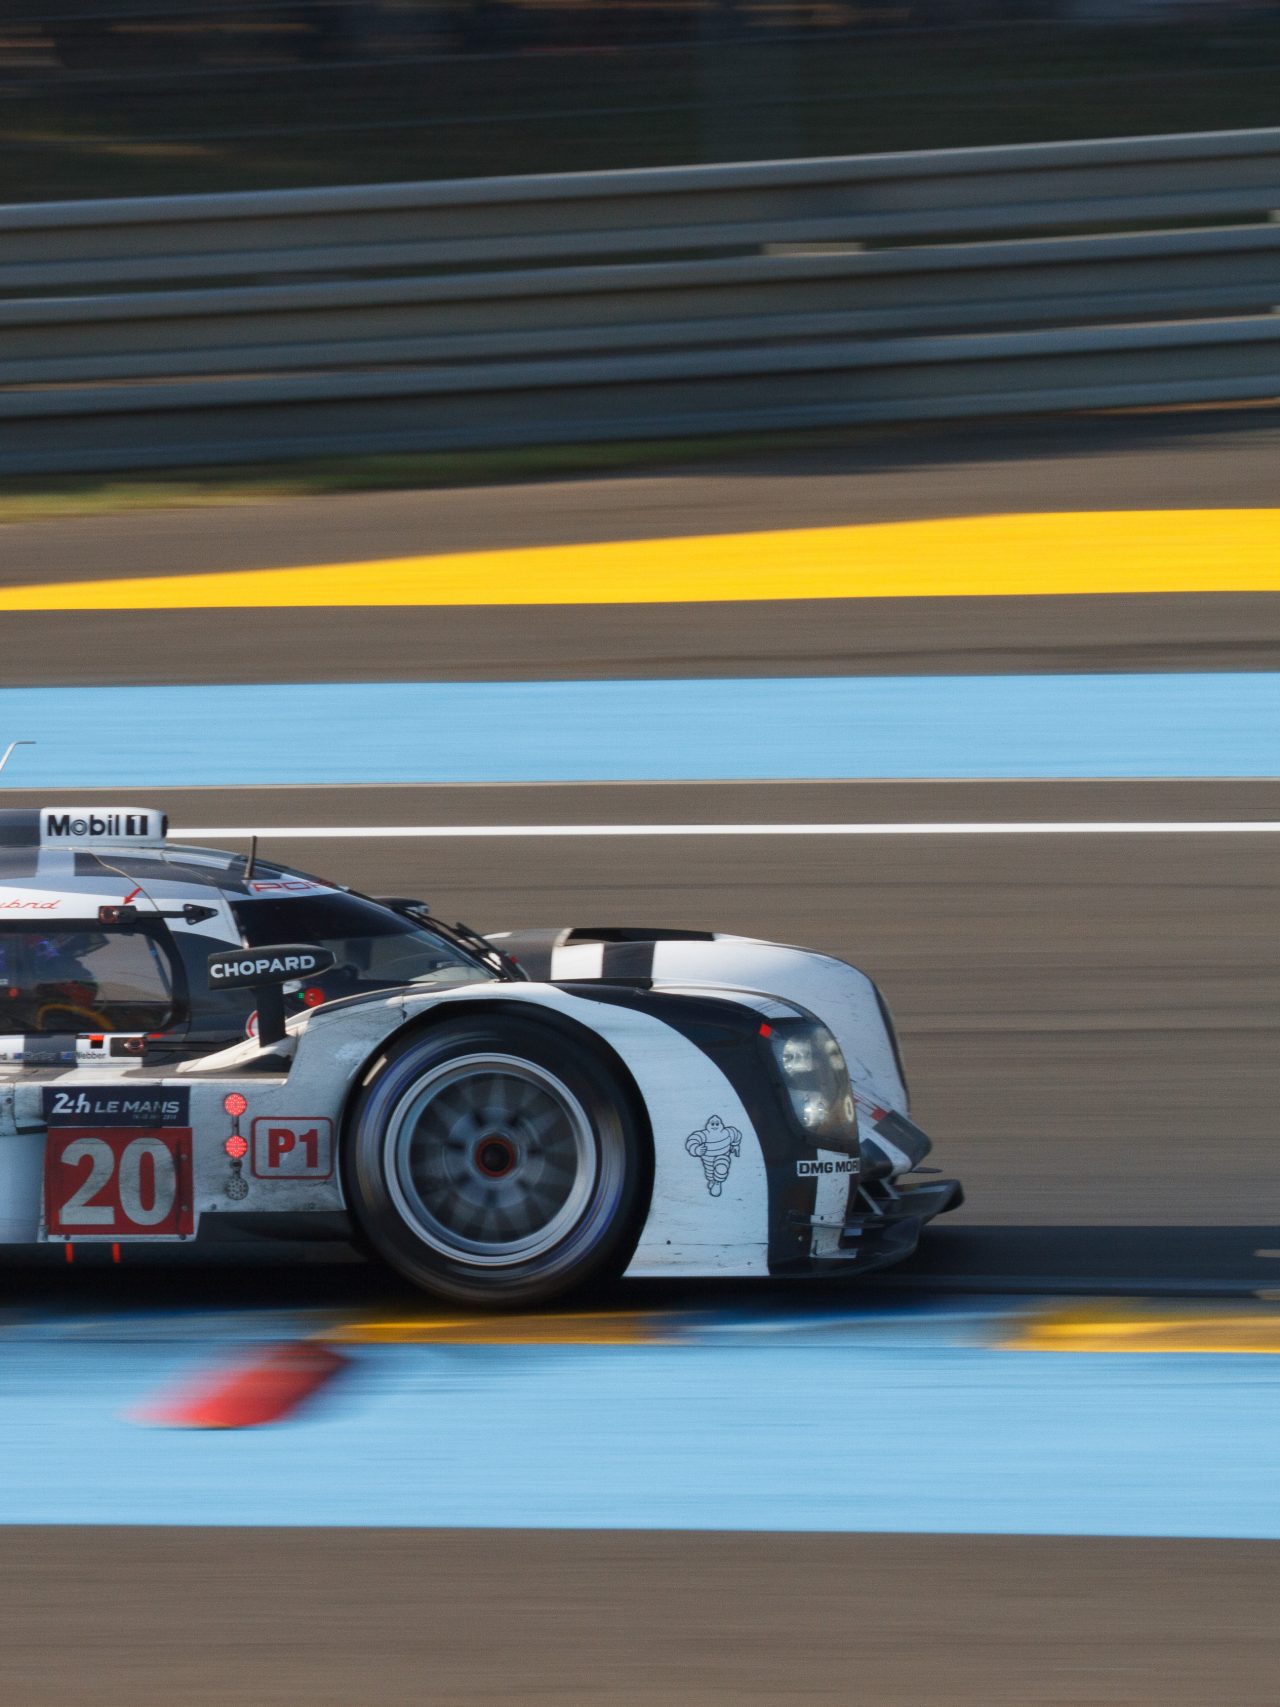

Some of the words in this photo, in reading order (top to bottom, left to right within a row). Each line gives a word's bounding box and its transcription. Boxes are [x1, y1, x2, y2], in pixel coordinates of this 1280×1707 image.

[47, 814, 120, 836] Mobil
[125, 815, 149, 836] 1
[210, 956, 316, 979] CHOPARD
[51, 1093, 91, 1114] 24h
[94, 1101, 120, 1113] LE
[122, 1101, 180, 1113] MANS
[268, 1128, 319, 1169] P1
[799, 1162, 833, 1174] DMG
[58, 1137, 177, 1226] 20
